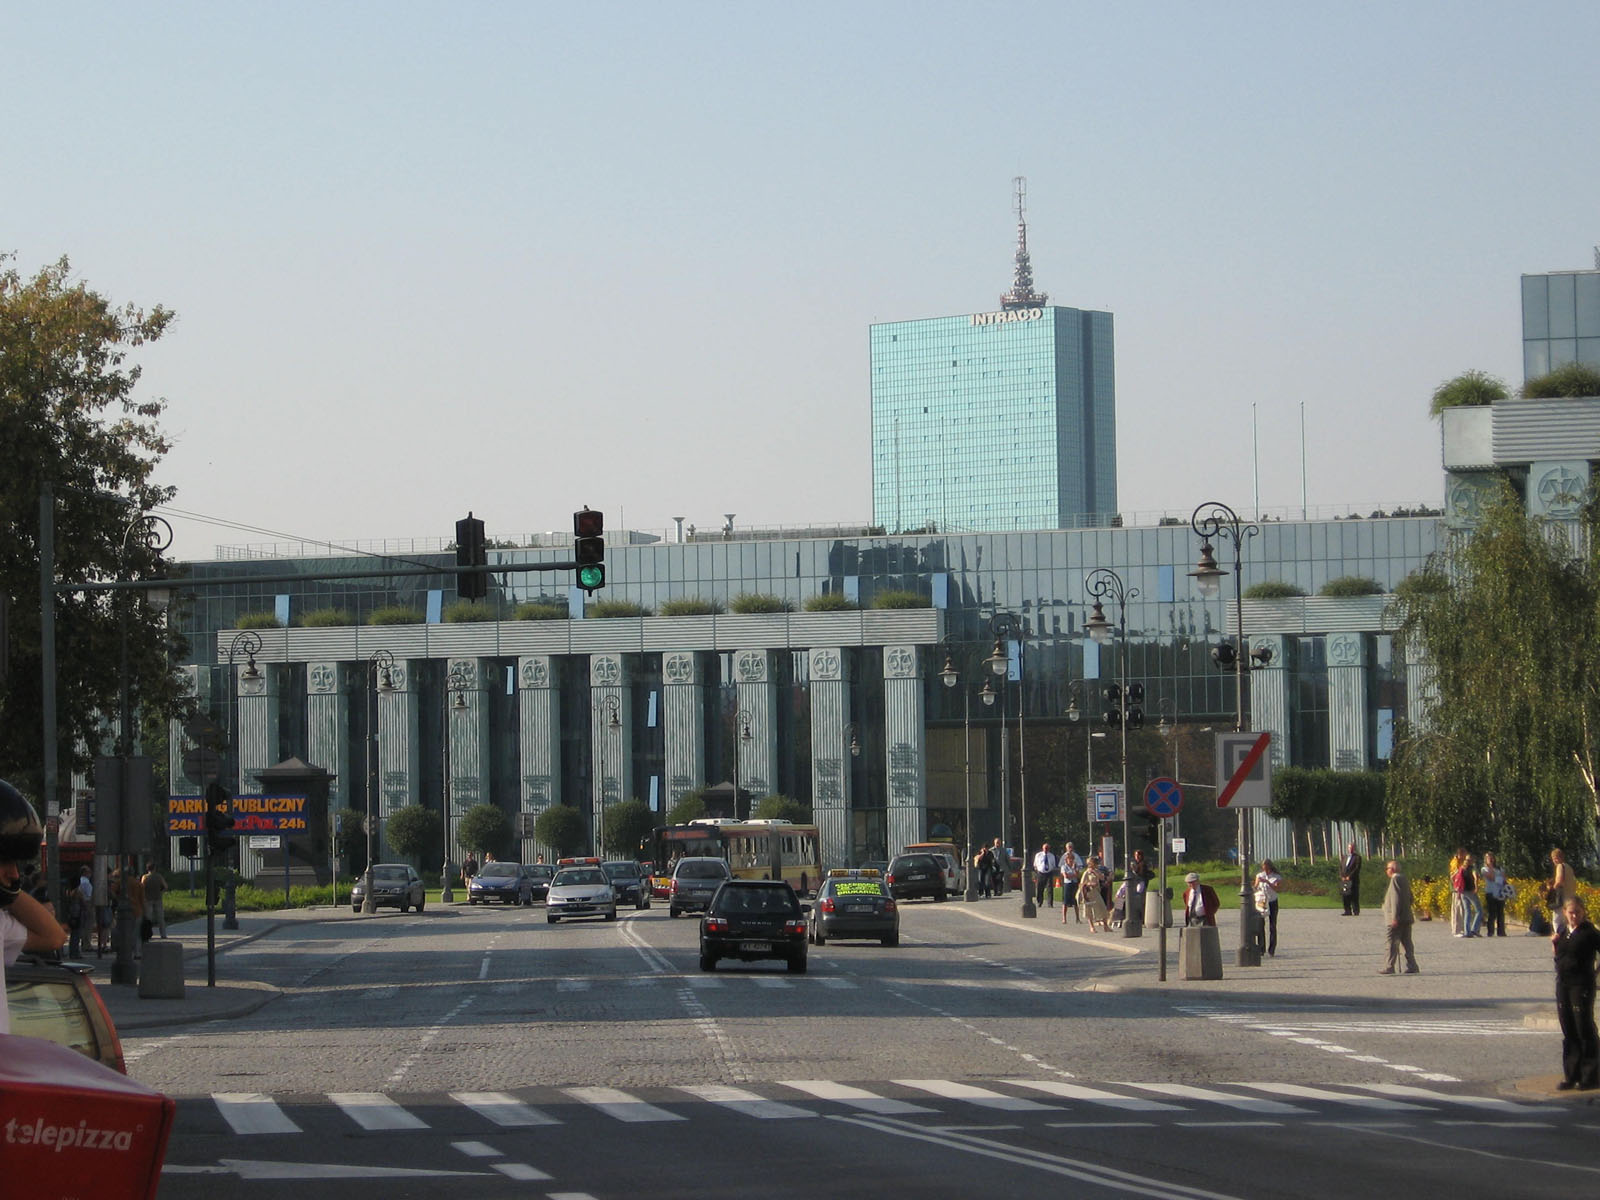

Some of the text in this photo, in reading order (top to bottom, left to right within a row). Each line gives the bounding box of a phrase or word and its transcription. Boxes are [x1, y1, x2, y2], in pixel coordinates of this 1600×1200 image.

[970, 308, 1042, 326] INTRACO
[232, 798, 305, 812] PUBLICZNY
[169, 818, 197, 831] 24h
[278, 817, 306, 830] 24h
[4, 1117, 133, 1153] telepizza
